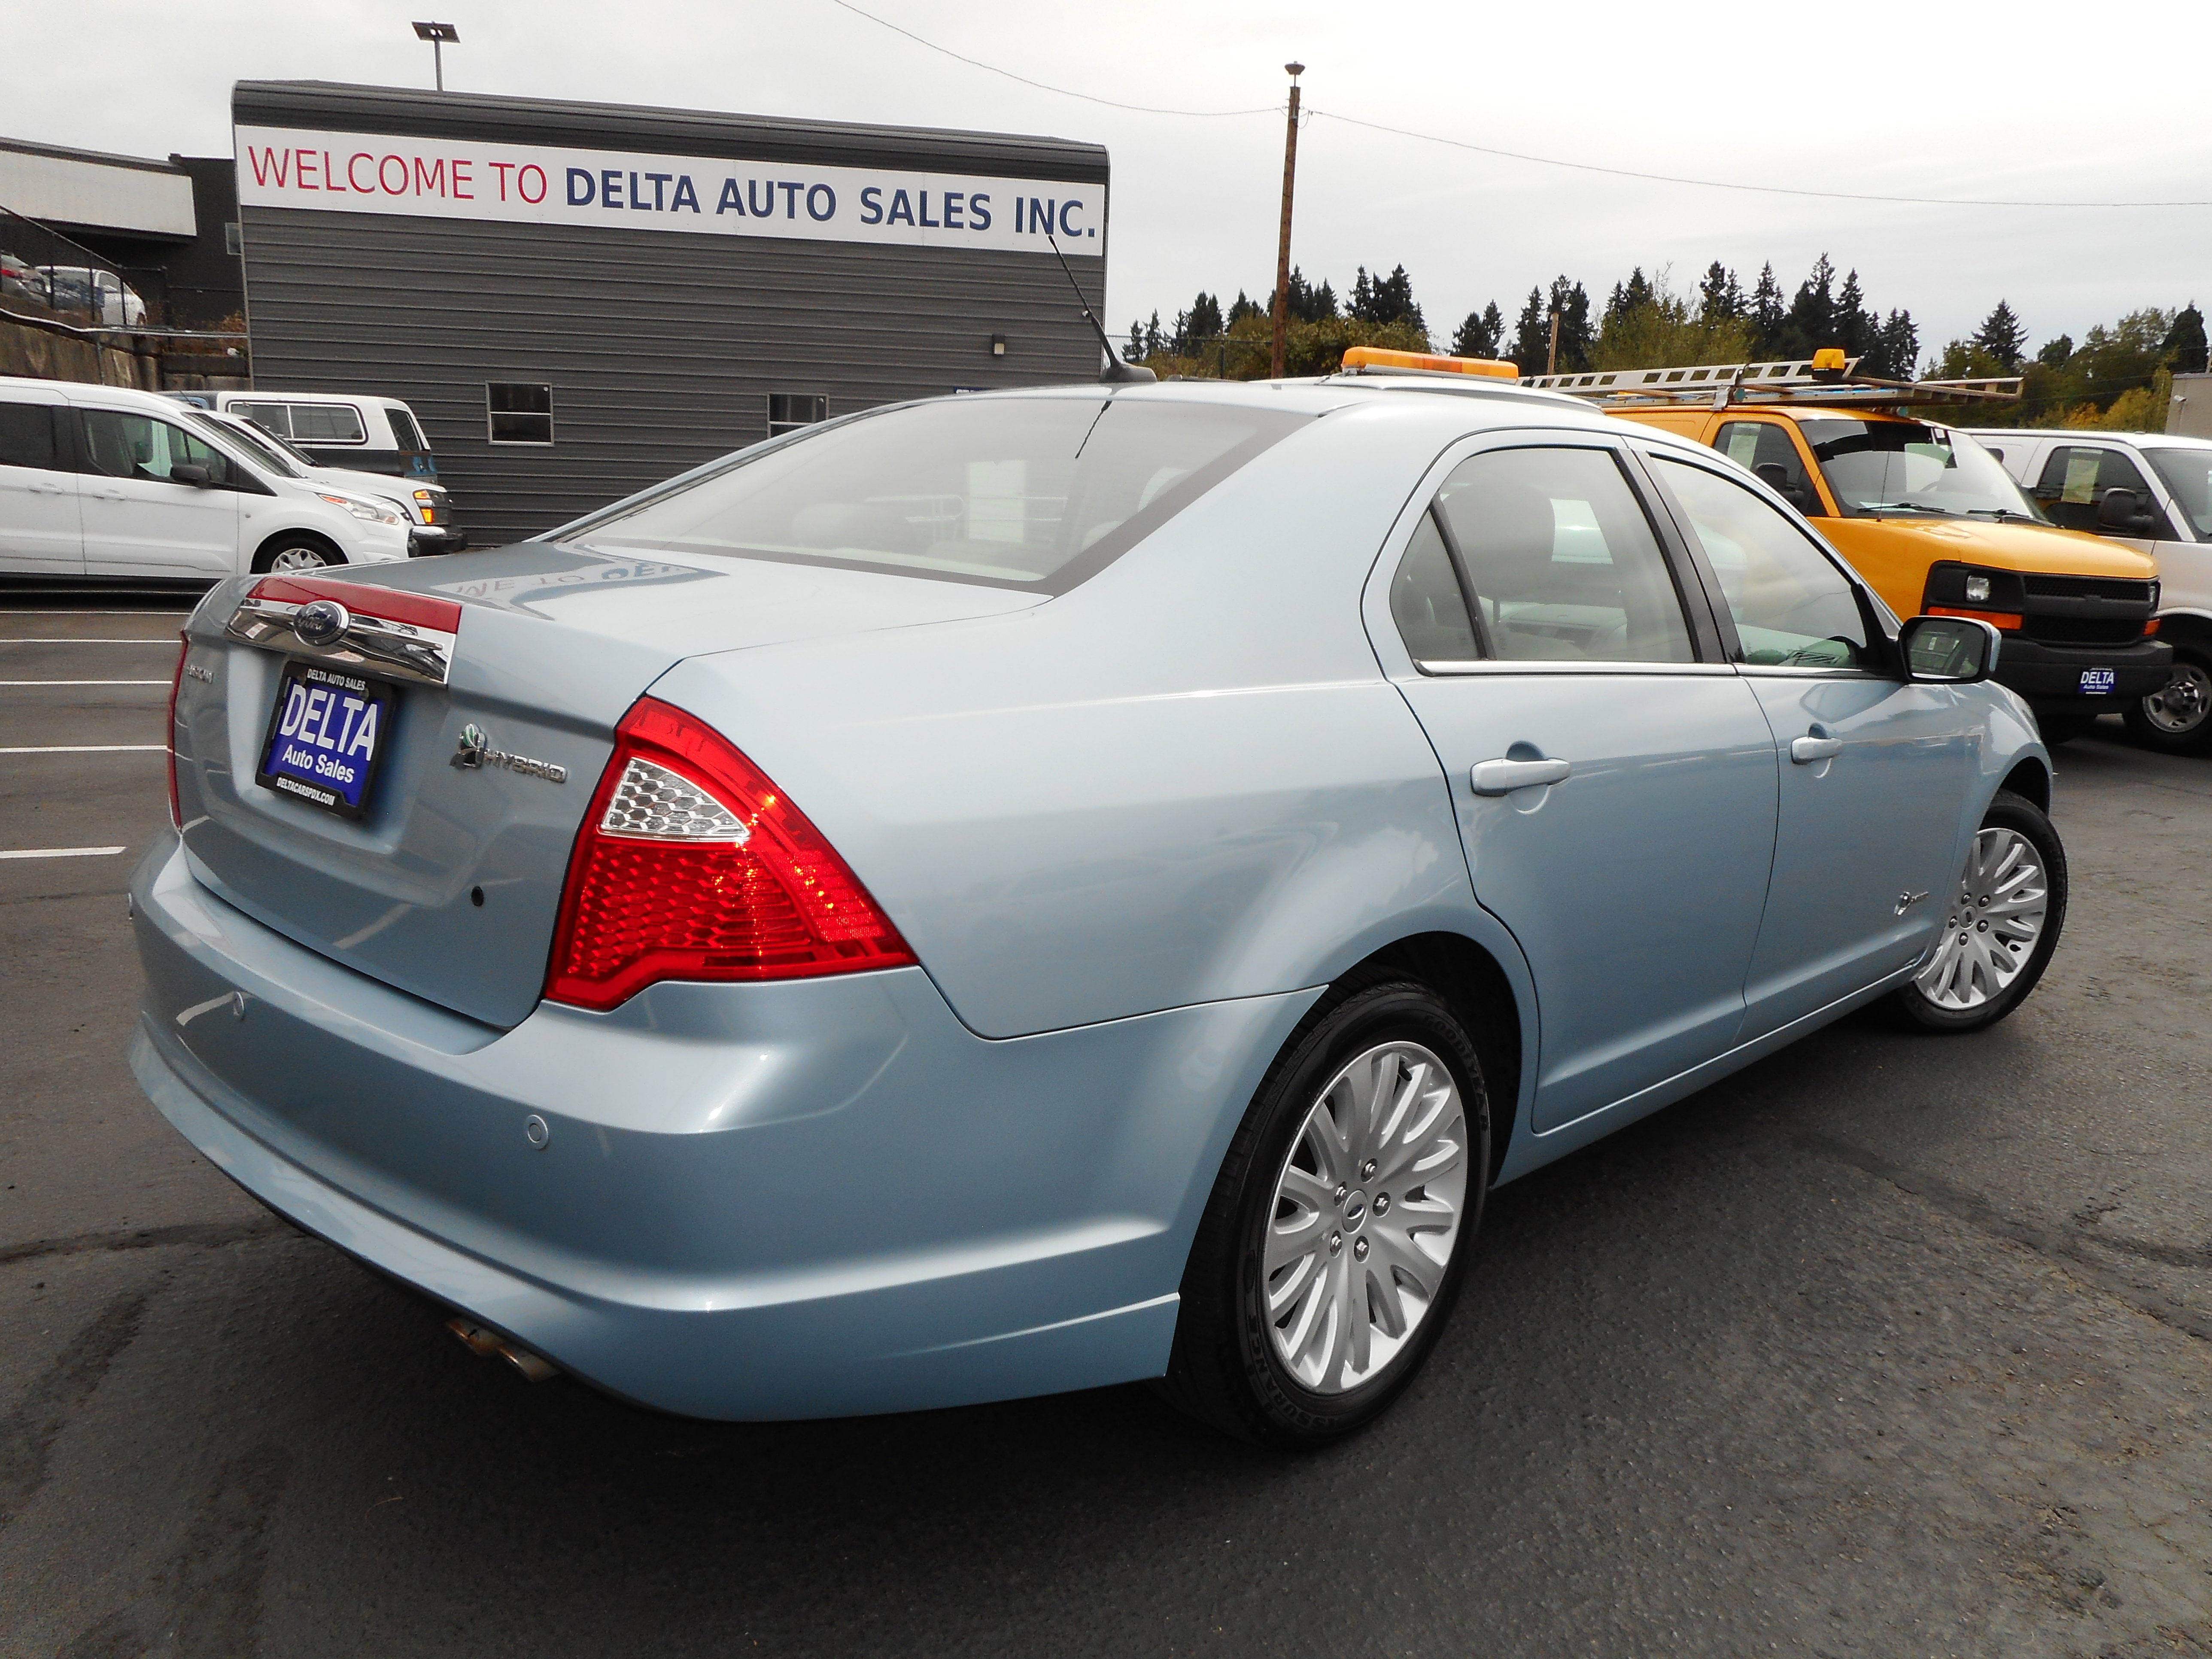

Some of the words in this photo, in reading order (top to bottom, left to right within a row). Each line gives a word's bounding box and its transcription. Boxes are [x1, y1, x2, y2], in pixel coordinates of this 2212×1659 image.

[248, 144, 475, 201] WELCOME
[488, 160, 548, 204] TO
[565, 167, 701, 214] DELTA
[715, 177, 837, 222] AUTO
[860, 186, 992, 231] SALES
[1015, 196, 1096, 238] INC.
[307, 668, 327, 682] DELTA
[327, 673, 345, 687] AUTO
[345, 677, 366, 691] SALES
[2080, 671, 2115, 684] DELTA
[280, 684, 378, 762] DELTA
[282, 744, 313, 770] Auto
[315, 754, 355, 784] Sales
[483, 748, 568, 784] HYBRID
[276, 776, 336, 806] DELTACARSPDX.COM
